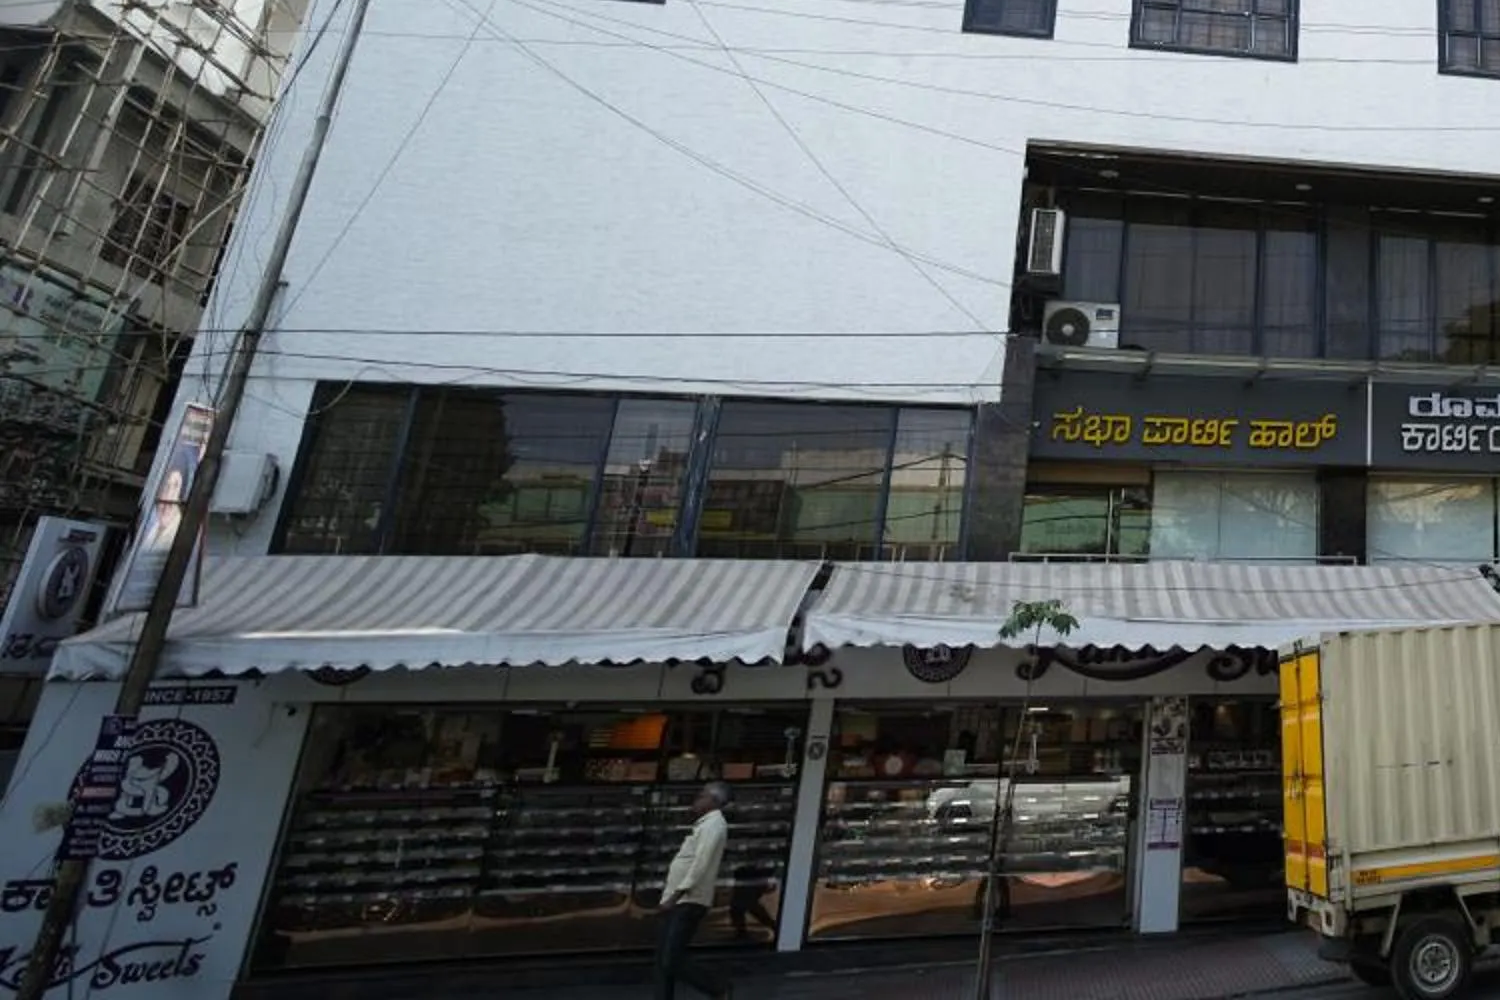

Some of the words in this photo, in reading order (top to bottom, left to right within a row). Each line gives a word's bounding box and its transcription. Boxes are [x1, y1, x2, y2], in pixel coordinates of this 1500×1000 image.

[1052, 406, 1132, 447] ಸಭಾ
[1143, 414, 1240, 446] ಪಾರ್ಟಿ
[1249, 414, 1338, 448] ಹಾಲ್
[143, 688, 233, 705] INCE-1957
[90, 937, 207, 990] Sweets
